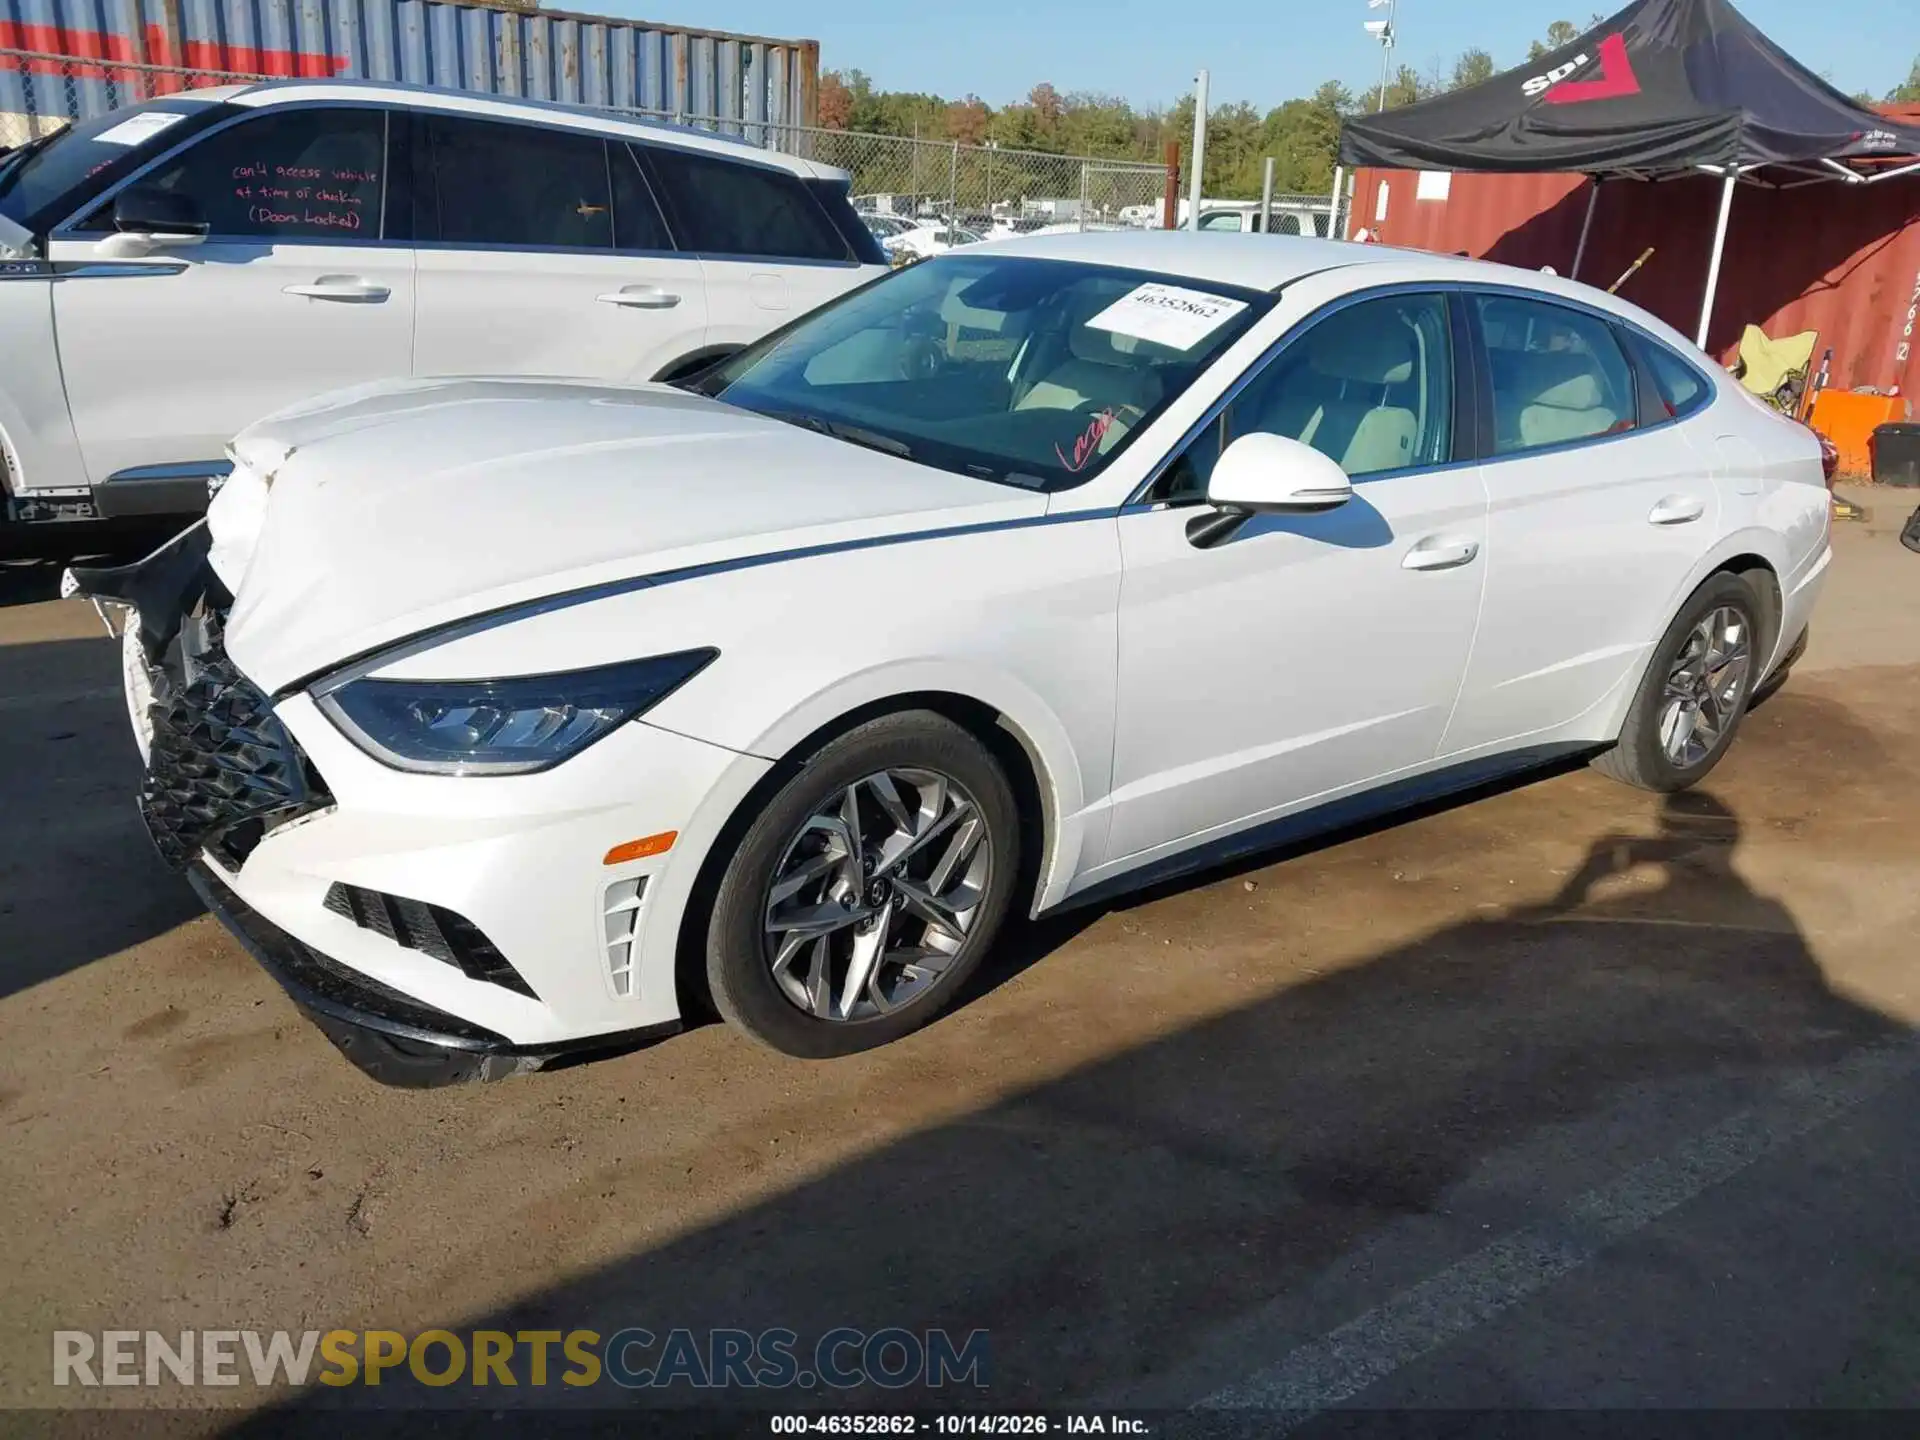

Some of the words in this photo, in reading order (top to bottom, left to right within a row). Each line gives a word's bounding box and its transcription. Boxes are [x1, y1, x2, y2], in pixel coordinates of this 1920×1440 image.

[276, 166, 321, 179] access
[235, 186, 252, 198] at
[259, 187, 290, 198] time
[1136, 293, 1219, 318] 46352862
